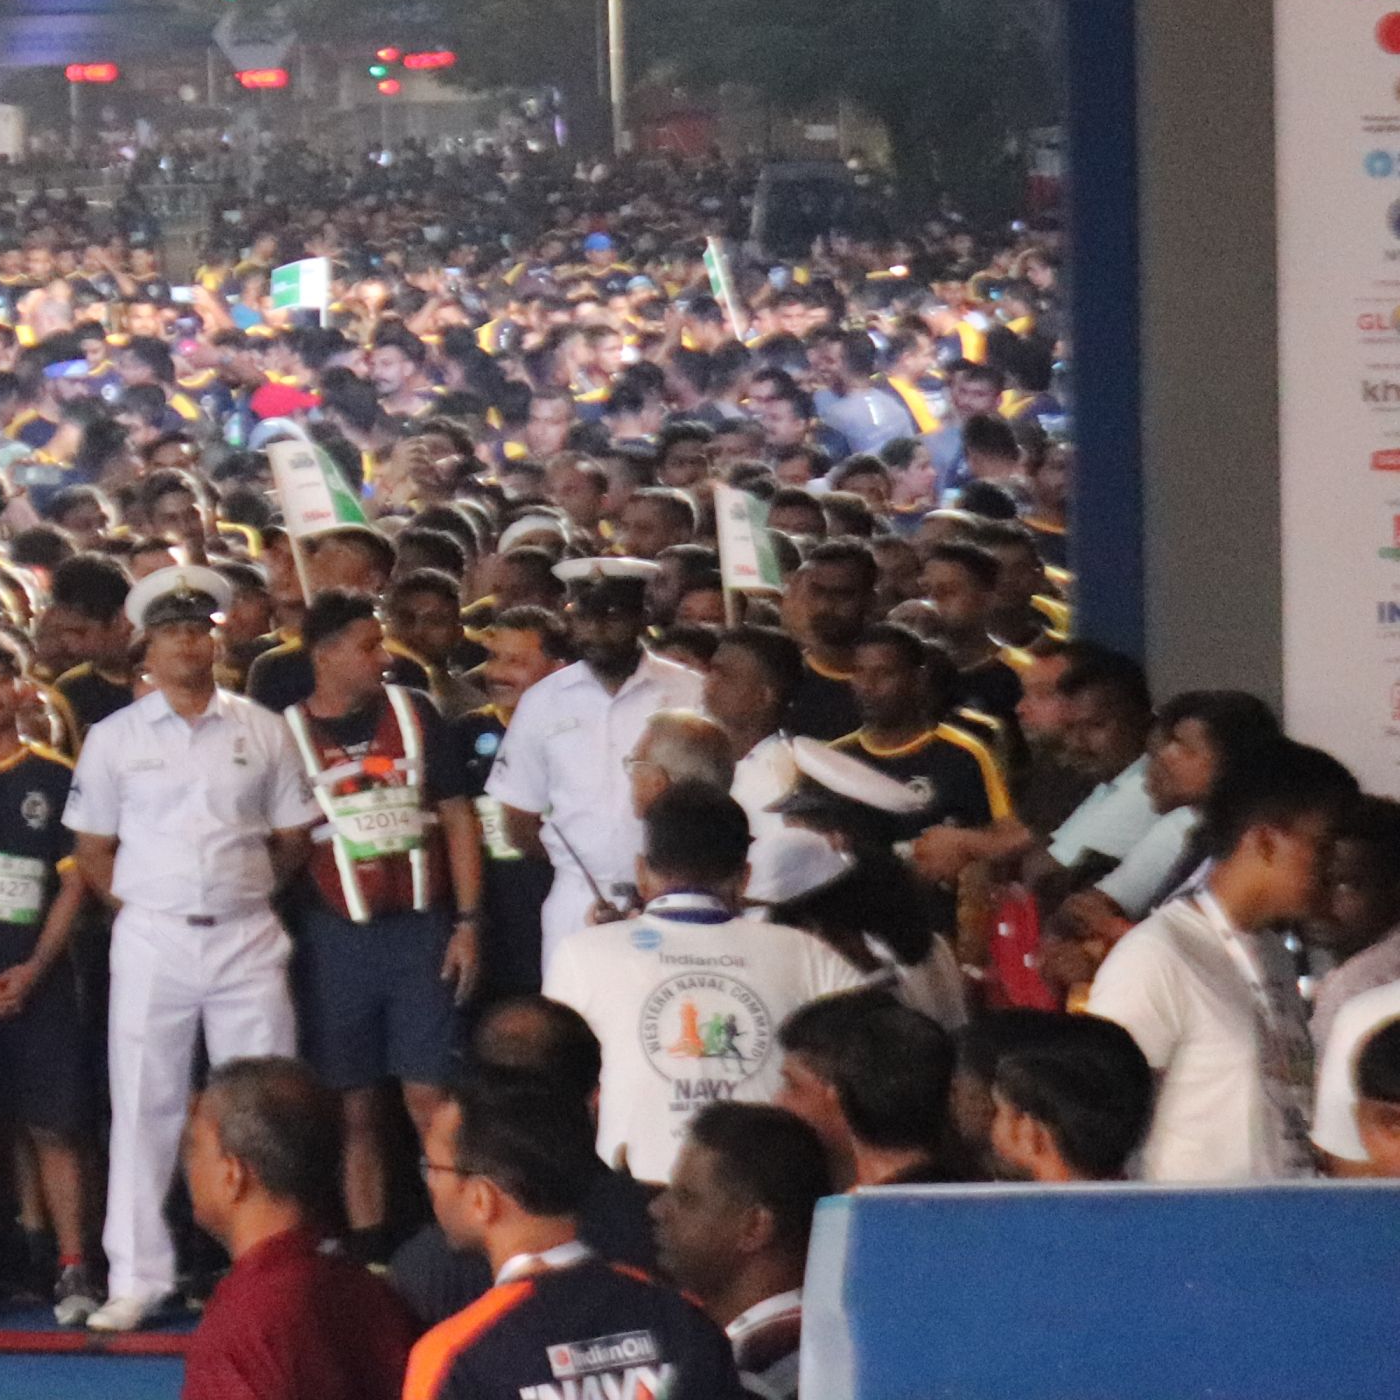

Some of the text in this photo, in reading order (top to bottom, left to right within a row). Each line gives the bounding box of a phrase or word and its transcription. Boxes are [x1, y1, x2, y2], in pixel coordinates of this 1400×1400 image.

[659, 952, 746, 968] IndianOil
[645, 976, 768, 1058] WESTERN NAVAL COMMAND
[675, 1078, 738, 1101] NAVY
